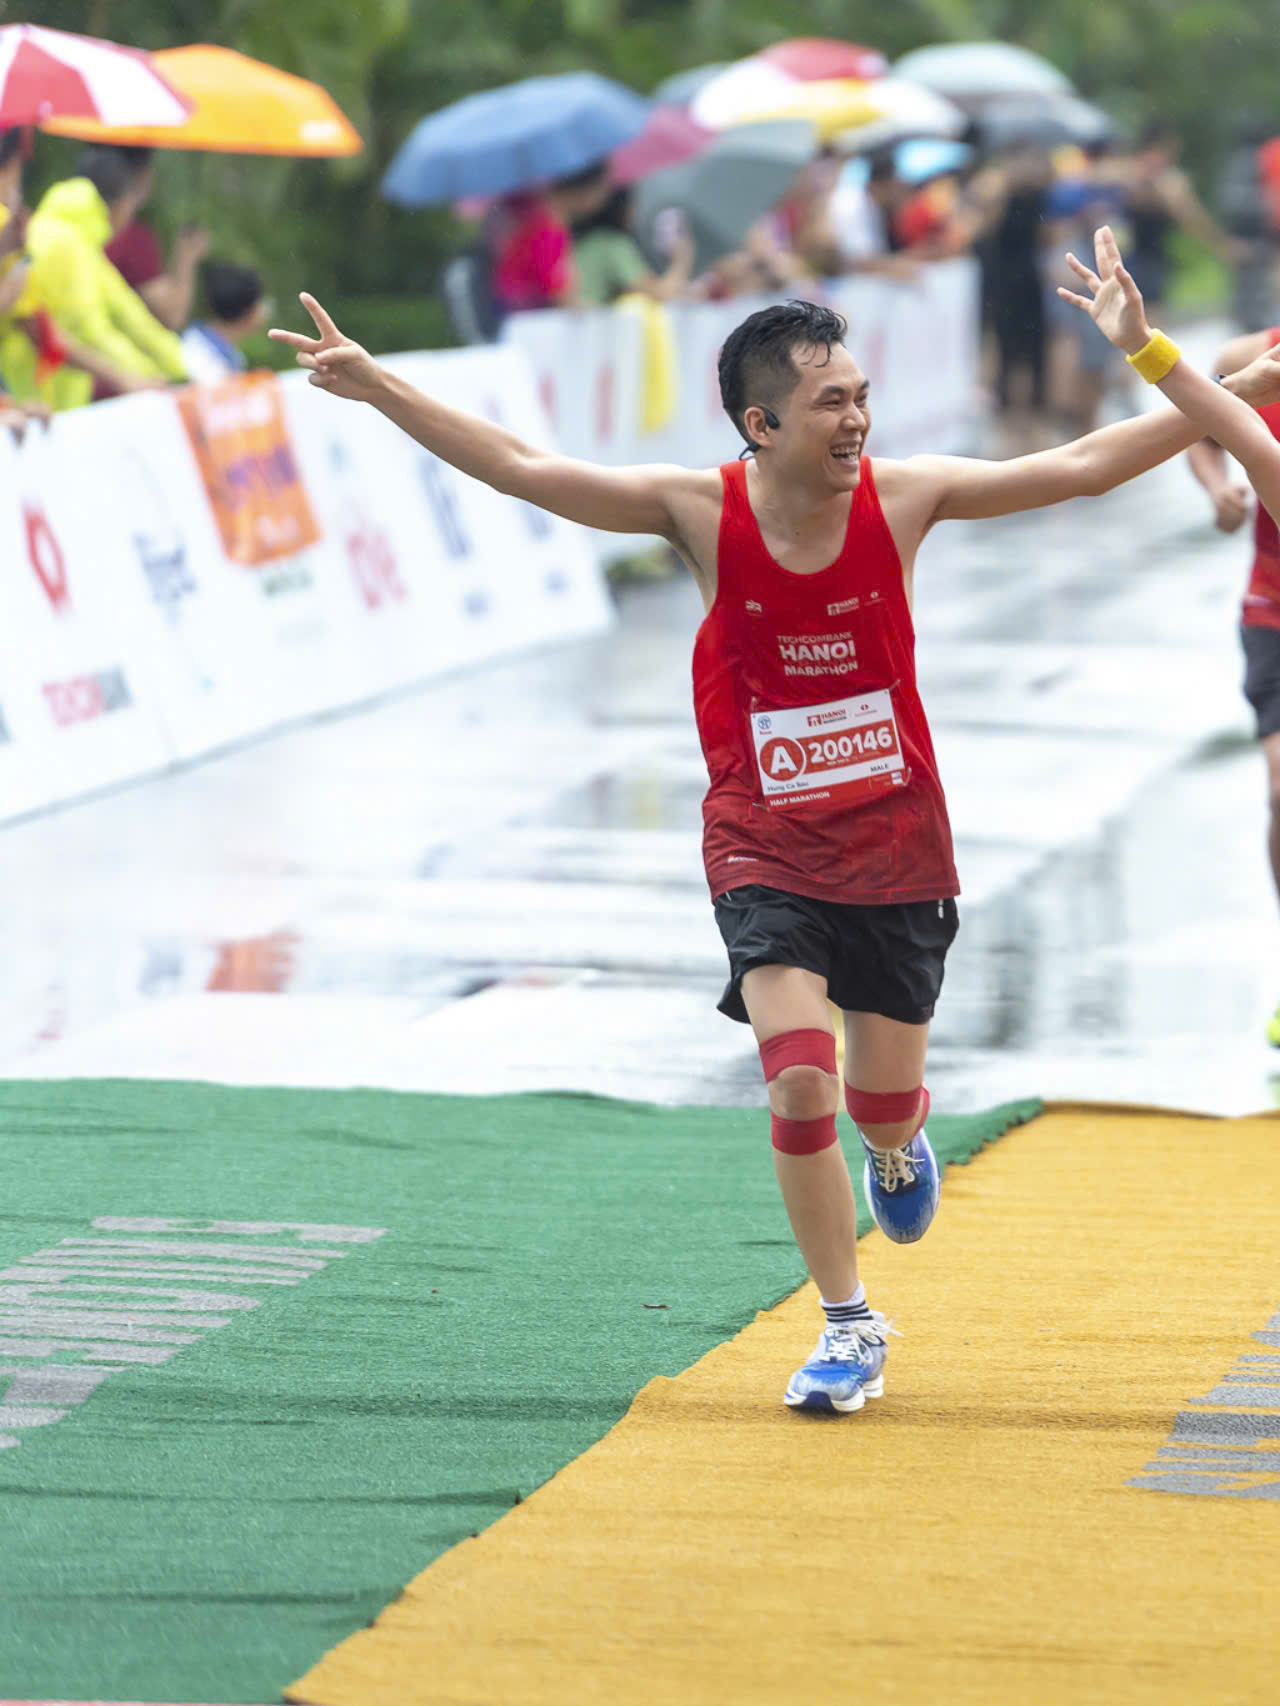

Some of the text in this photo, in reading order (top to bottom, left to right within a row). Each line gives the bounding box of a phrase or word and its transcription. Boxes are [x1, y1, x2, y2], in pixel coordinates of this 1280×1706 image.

[776, 631, 853, 644] TECHCOMBANK
[779, 640, 857, 661] HANOI
[784, 661, 859, 676] MARATHON
[769, 726, 893, 775] A 200146
[870, 763, 889, 773] MALE
[769, 791, 831, 806] HALF MARATHON
